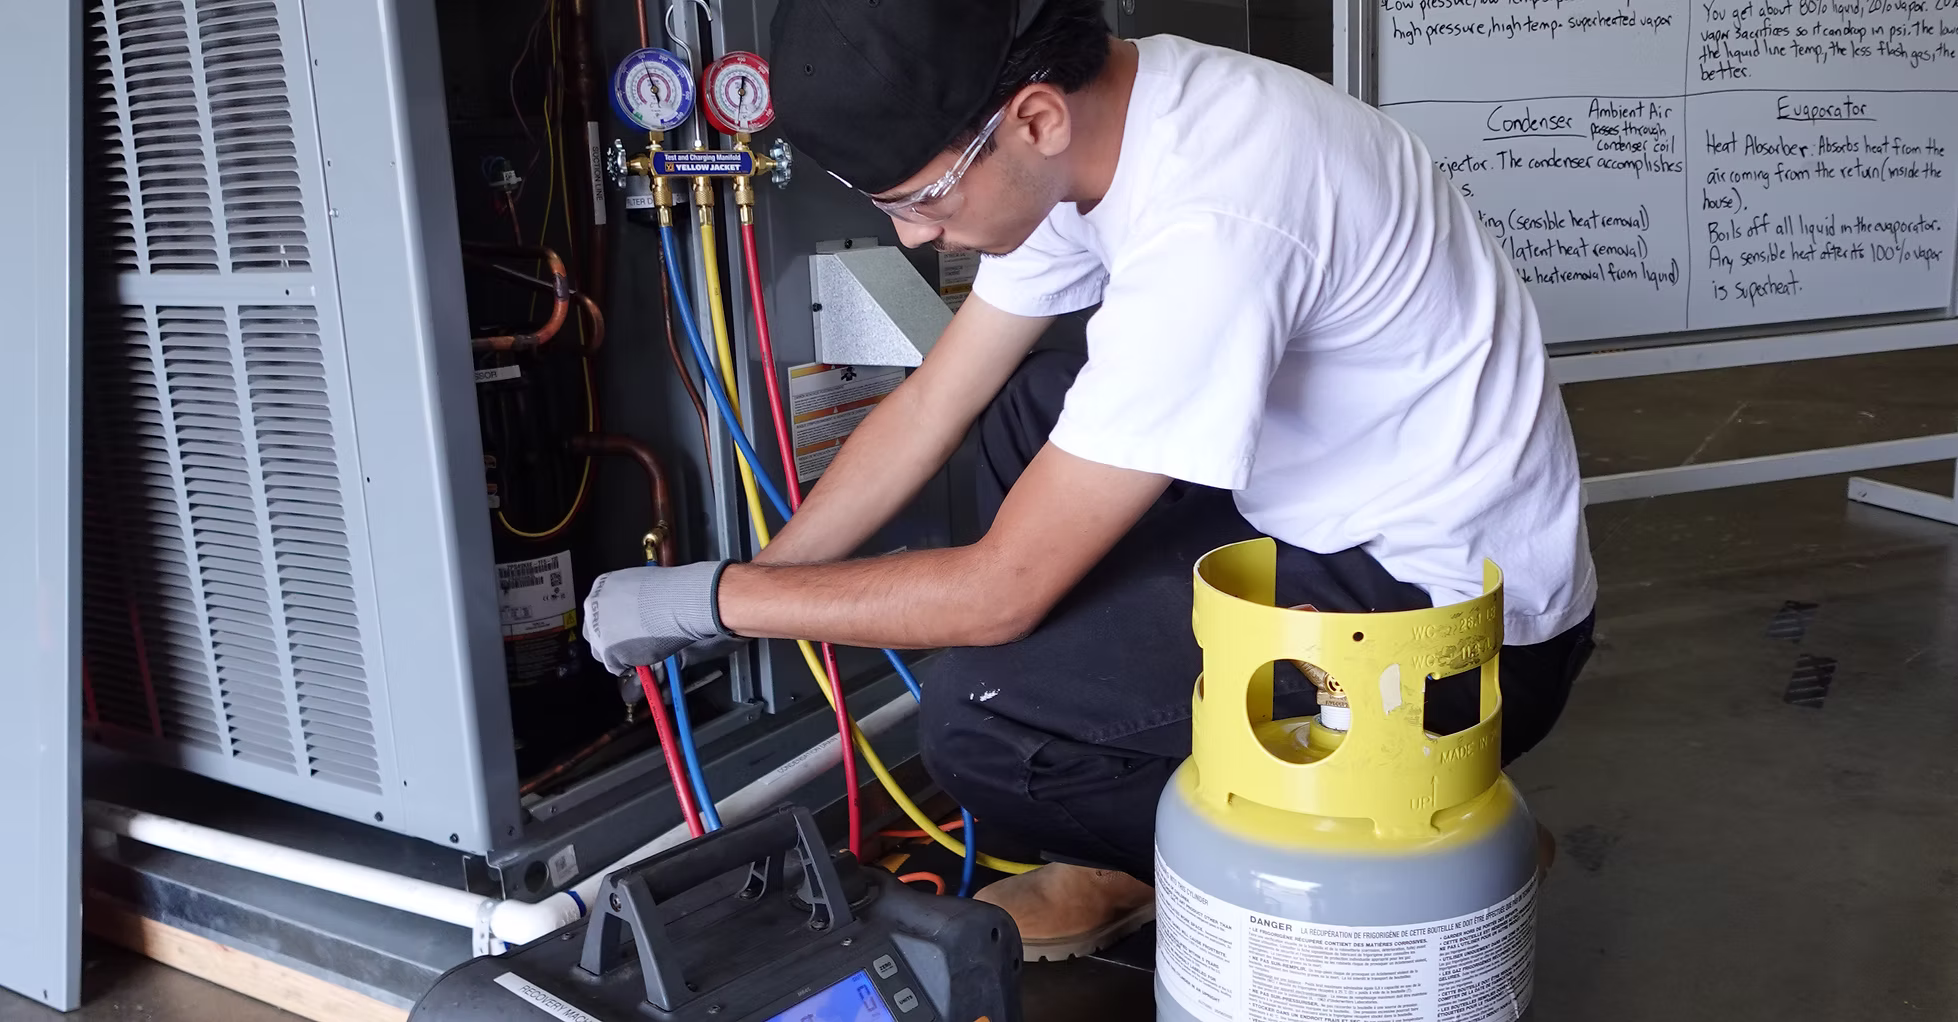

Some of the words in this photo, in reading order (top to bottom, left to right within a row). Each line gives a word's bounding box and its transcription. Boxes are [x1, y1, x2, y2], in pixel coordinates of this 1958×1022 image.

[1392, 16, 1422, 45] high
[1491, 15, 1521, 39] high
[1568, 9, 1636, 32] superheated
[1703, 0, 1725, 23] You
[1733, 1, 1753, 30] get
[1759, 0, 1792, 17] about
[1796, 26, 1808, 36] so
[1822, 28, 1842, 36] can
[1843, 20, 1867, 43] drop
[1872, 26, 1884, 35] in
[1890, 24, 1911, 43] psi.
[1912, 19, 1934, 36] The
[1699, 44, 1721, 63] the
[1723, 39, 1760, 63] liquid
[1763, 38, 1786, 56] line
[1828, 41, 1847, 56] the
[1850, 41, 1872, 58] less
[1877, 41, 1908, 58] flash
[1911, 49, 1935, 69] gas,
[1936, 43, 1956, 58] the
[1700, 60, 1751, 81] better.
[1486, 105, 1573, 132] Condenser
[1588, 98, 1645, 119] Ambient
[1649, 102, 1673, 120] Air
[1777, 95, 1867, 124] Evaporator
[1622, 120, 1667, 142] through
[1653, 135, 1675, 154] coil
[1705, 129, 1738, 155] Heat
[1818, 134, 1860, 156] Absorbs
[1863, 134, 1890, 155] heat
[1891, 136, 1922, 156] from
[1925, 136, 1945, 157] the
[592, 146, 601, 181] SUCTION
[690, 154, 716, 163] Charging
[1496, 149, 1523, 170] The
[1528, 148, 1594, 169] condenser
[1597, 152, 1683, 180] accomplishes
[1706, 167, 1727, 185] air
[1729, 170, 1771, 190] coming
[1774, 161, 1811, 183] from
[1814, 160, 1836, 179] the
[1840, 156, 1881, 180] return
[1921, 162, 1943, 180] the
[595, 182, 604, 201] LINE
[1702, 187, 1749, 215] house).
[1508, 208, 1566, 231] (sensible
[1568, 209, 1600, 230] heat
[1601, 204, 1650, 232] removal)
[1708, 218, 1743, 244] Boils
[1747, 212, 1771, 238] off
[1776, 214, 1794, 236] all
[1799, 212, 1837, 245] liquid
[1840, 223, 1853, 234] in
[1854, 215, 1873, 235] the
[1874, 213, 1942, 245] evaporator.
[1556, 239, 1590, 258] heat
[1592, 234, 1648, 260] removal)
[1708, 245, 1734, 275] Any
[1740, 242, 1786, 267] sensible
[1790, 241, 1818, 262] heat
[1820, 241, 1850, 262] after
[1871, 238, 1912, 264] 100%
[1913, 245, 1944, 271] vapor
[1534, 266, 1559, 284] heat
[1559, 262, 1606, 283] removal
[1607, 261, 1638, 283] from
[1640, 257, 1680, 291] liquid)
[1711, 280, 1729, 301] is
[1735, 269, 1803, 308] superheat.
[1412, 625, 1435, 640] WC
[1412, 655, 1435, 670] WC
[1441, 742, 1474, 764] MADE
[1410, 796, 1432, 810] UP
[1250, 915, 1293, 932] DANGER
[1354, 931, 1361, 939] DE
[1410, 928, 1426, 936] CETTE
[1427, 923, 1454, 935] BOUTEILLE
[1455, 921, 1461, 929] NE
[1463, 919, 1473, 928] DOIT
[879, 962, 892, 971] ZERO
[520, 985, 567, 1012] RECOVERY
